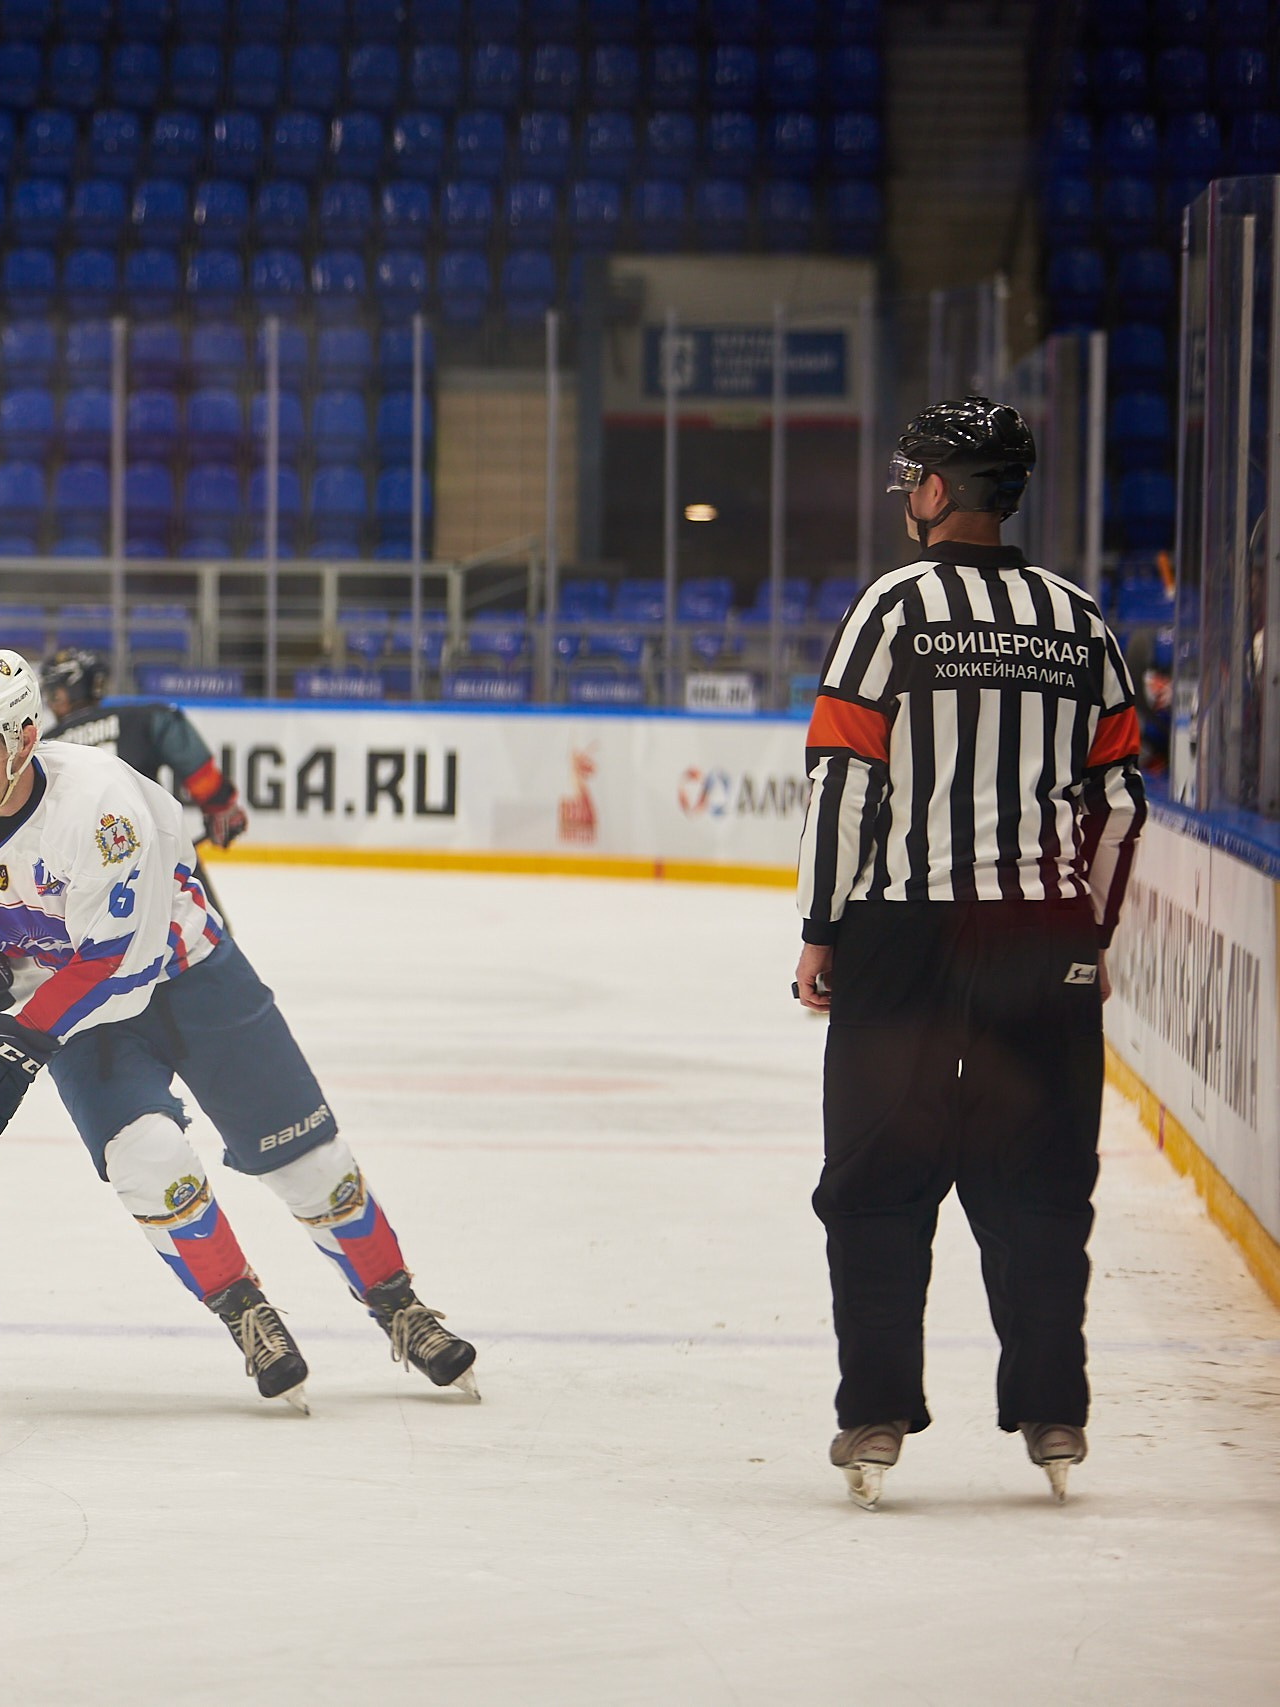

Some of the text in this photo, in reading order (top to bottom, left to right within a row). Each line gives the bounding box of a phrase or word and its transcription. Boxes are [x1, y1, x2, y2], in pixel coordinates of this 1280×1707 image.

[913, 631, 1090, 668] ОФИЦЕРСКАЯ
[934, 658, 1076, 688] ХОККЕЙНАЯ ЛИГА
[174, 743, 458, 817] IGA.RU
[108, 869, 141, 918] 6
[260, 1104, 331, 1153] BAUER
